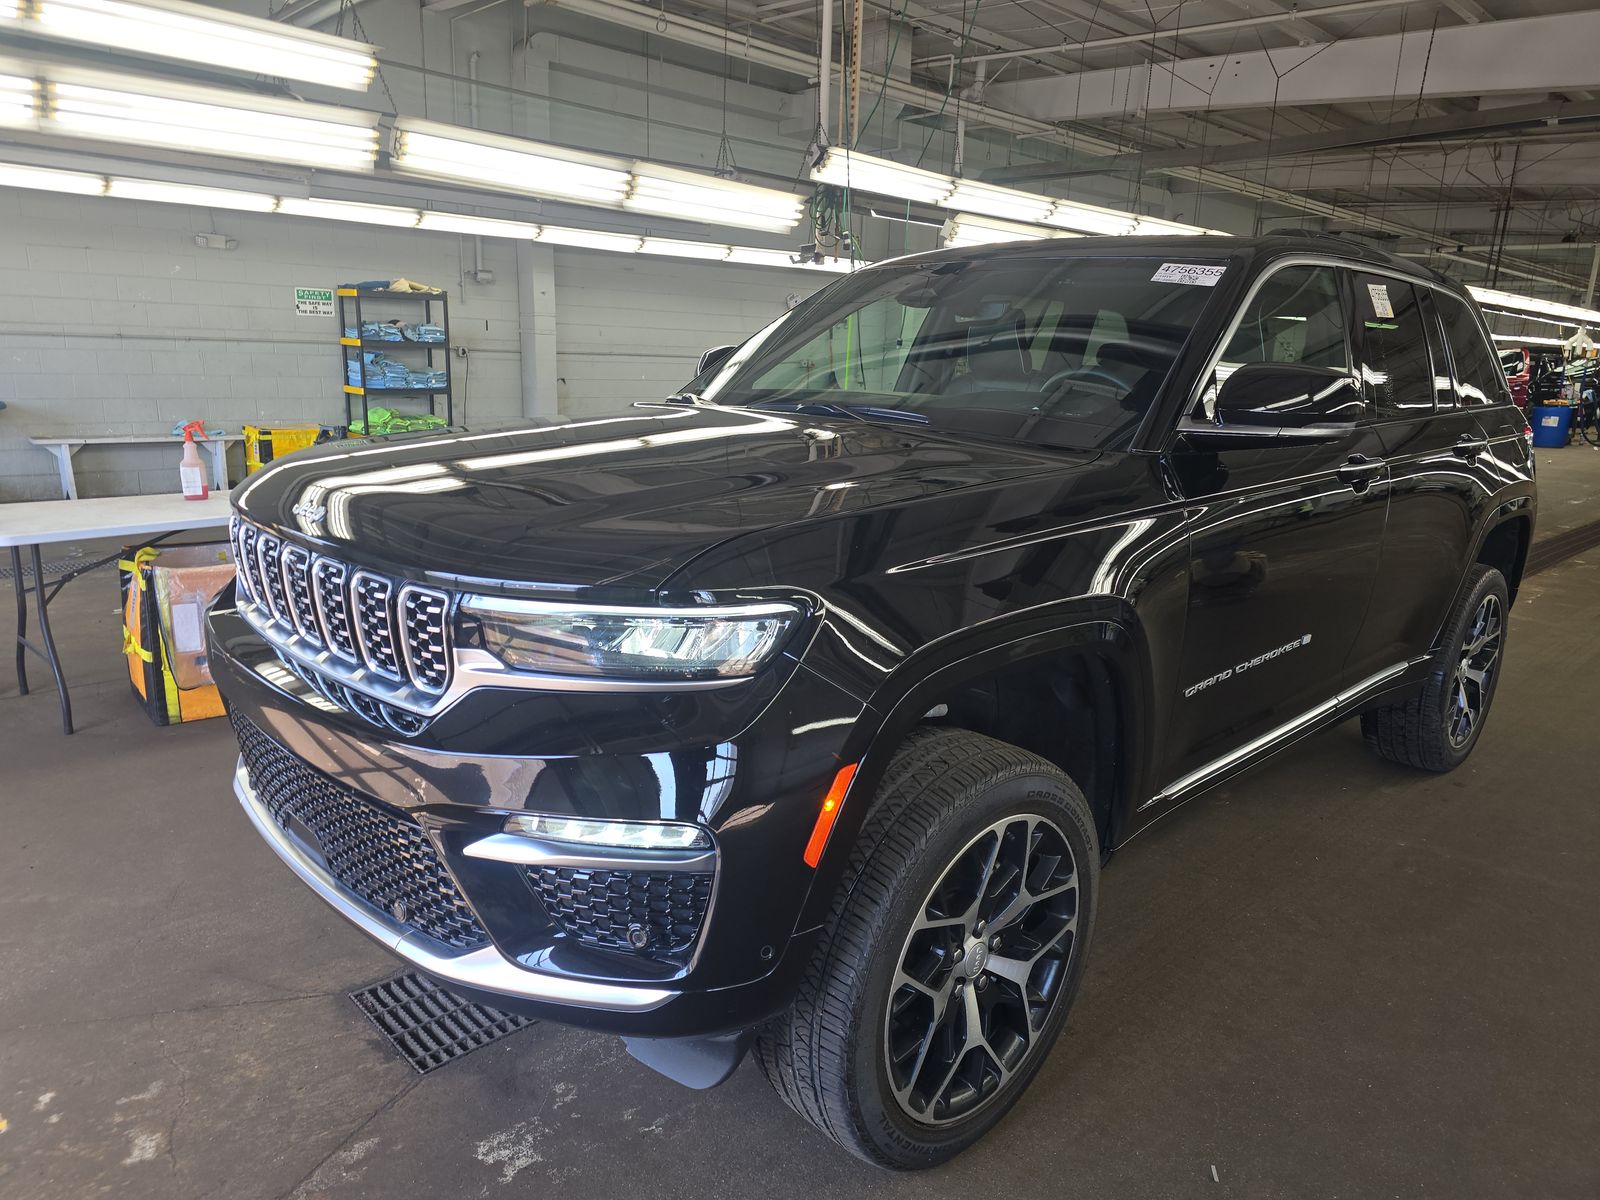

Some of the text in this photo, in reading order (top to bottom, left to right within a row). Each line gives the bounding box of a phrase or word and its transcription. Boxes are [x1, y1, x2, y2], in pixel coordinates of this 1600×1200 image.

[1161, 265, 1223, 277] 4756355
[298, 289, 330, 298] SAFETY
[292, 500, 326, 523] Jeep
[1184, 639, 1302, 698] GRAND CHEROKEE
